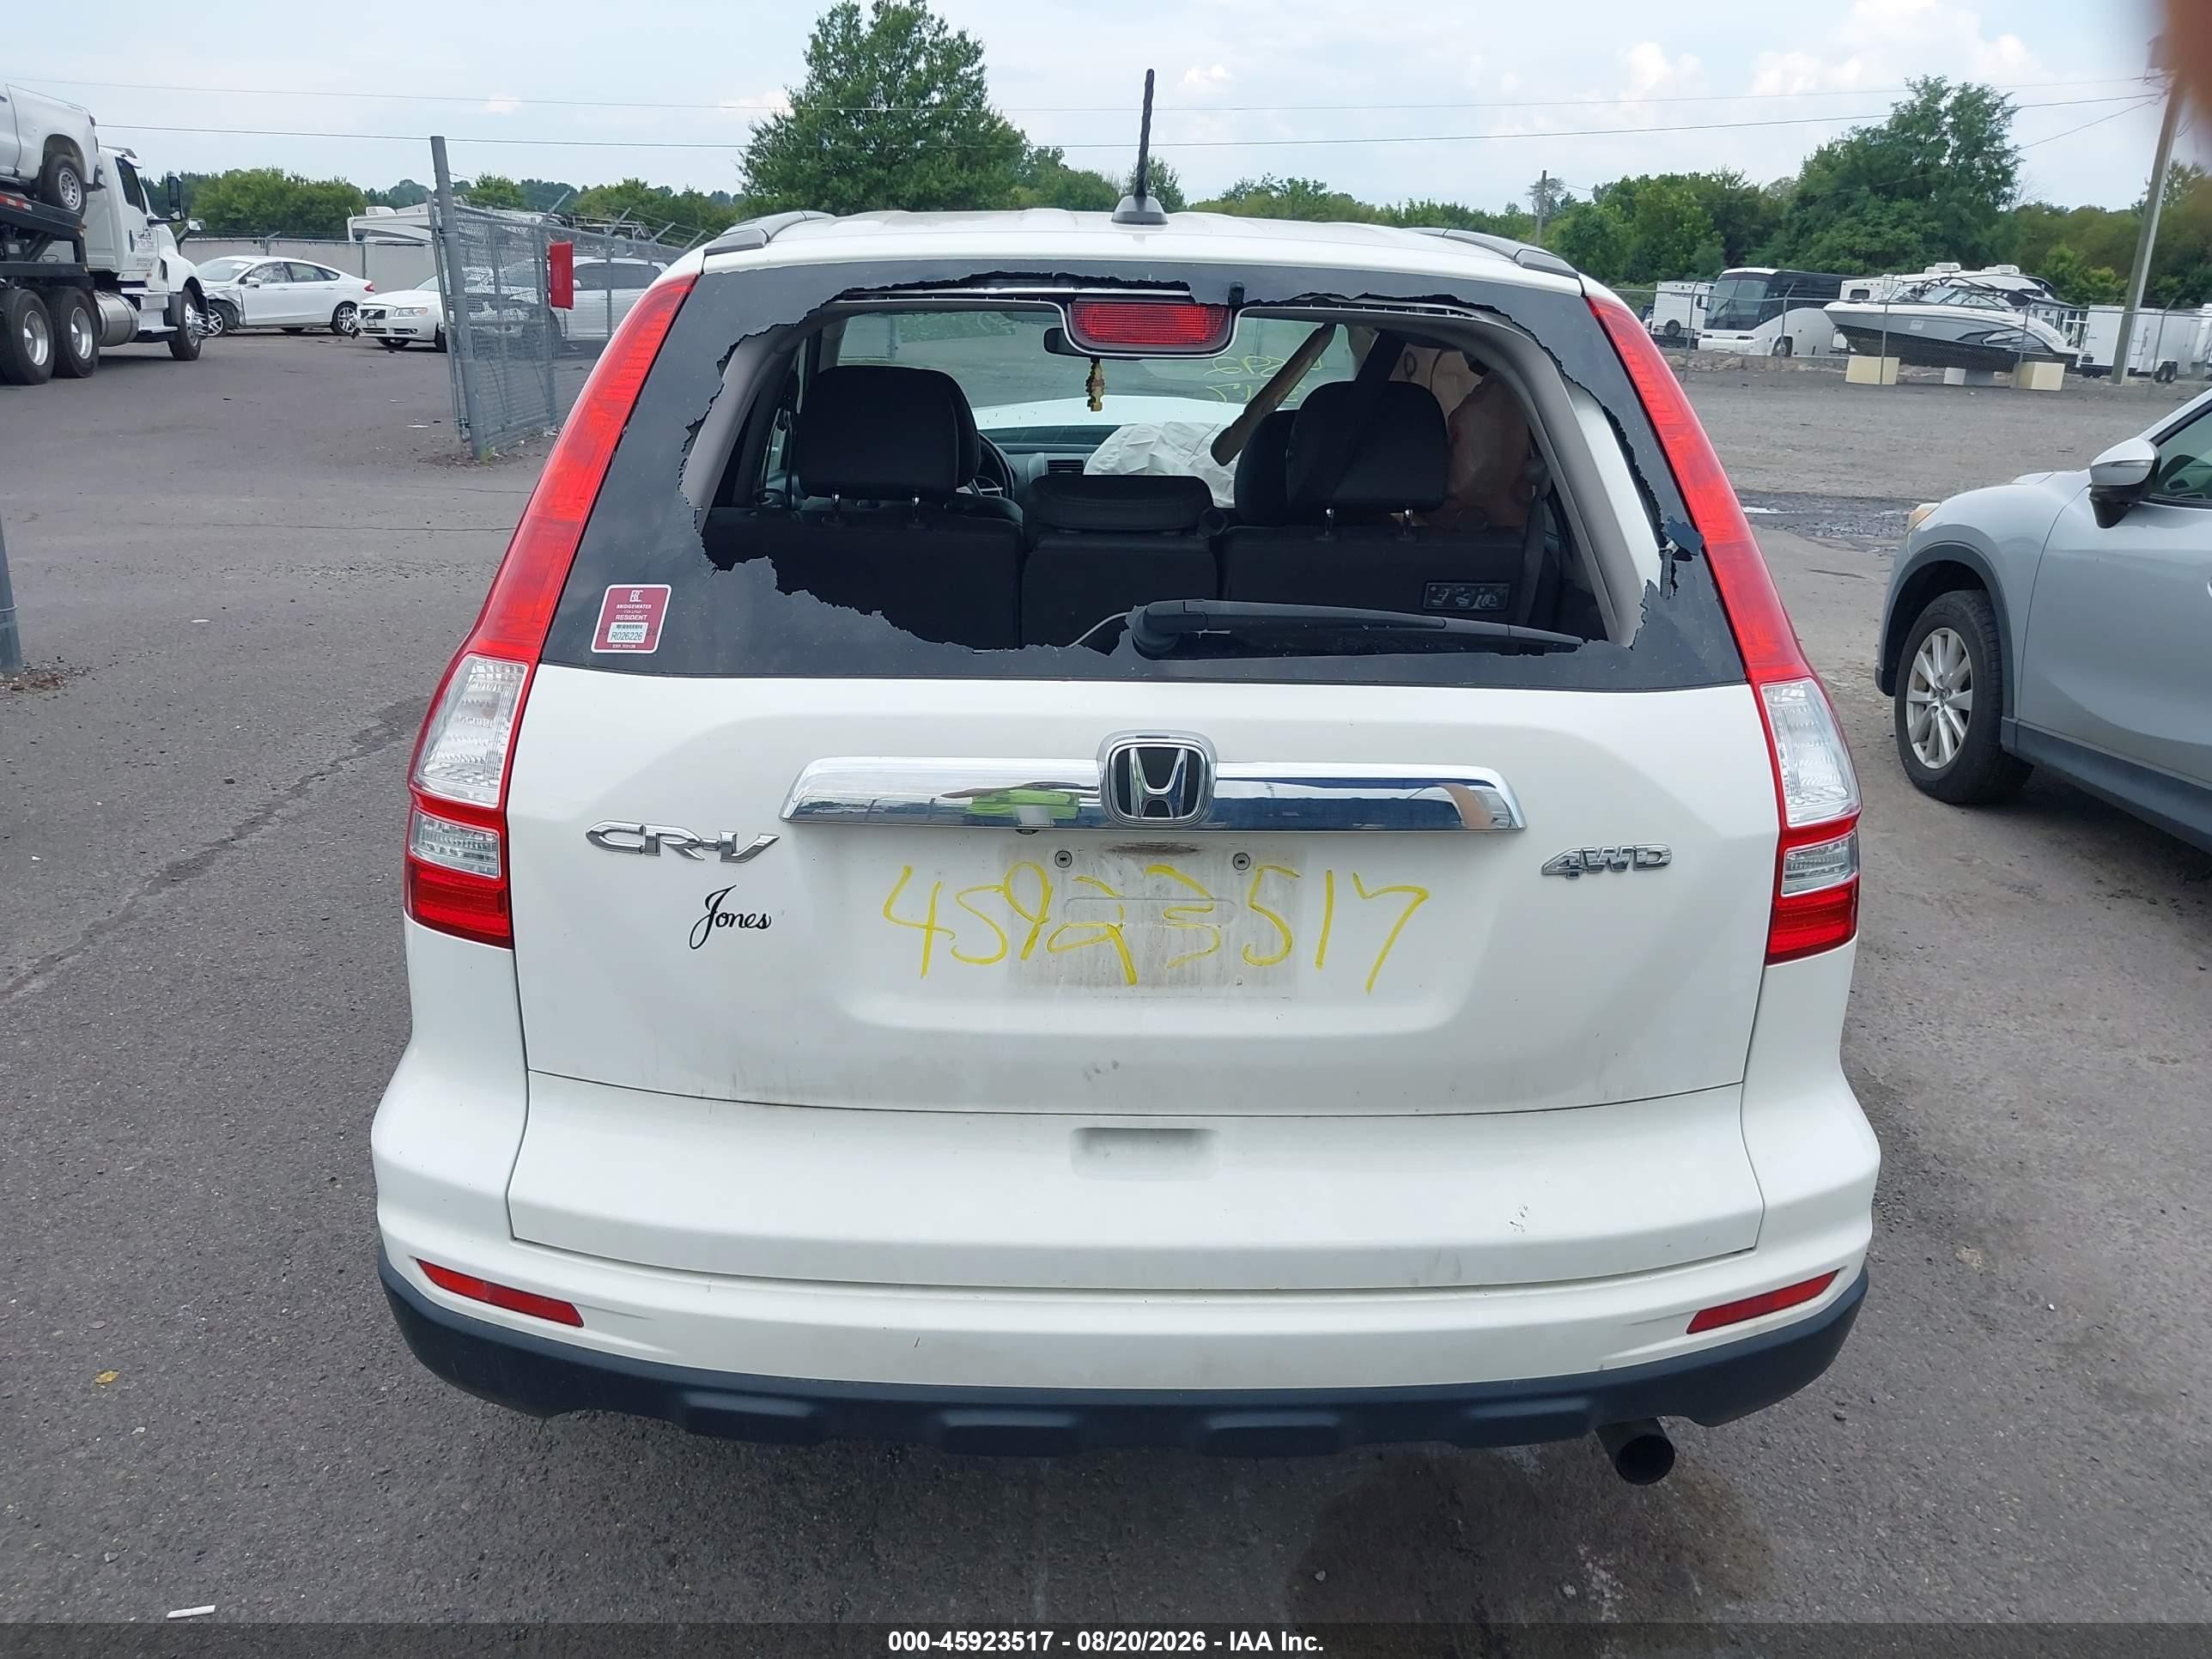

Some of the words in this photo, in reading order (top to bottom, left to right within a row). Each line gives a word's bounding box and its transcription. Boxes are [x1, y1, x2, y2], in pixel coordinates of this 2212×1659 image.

[611, 631, 643, 641] R026226
[586, 819, 781, 864] CR-V
[1540, 843, 1672, 879] 4WD
[689, 884, 772, 950] Jones
